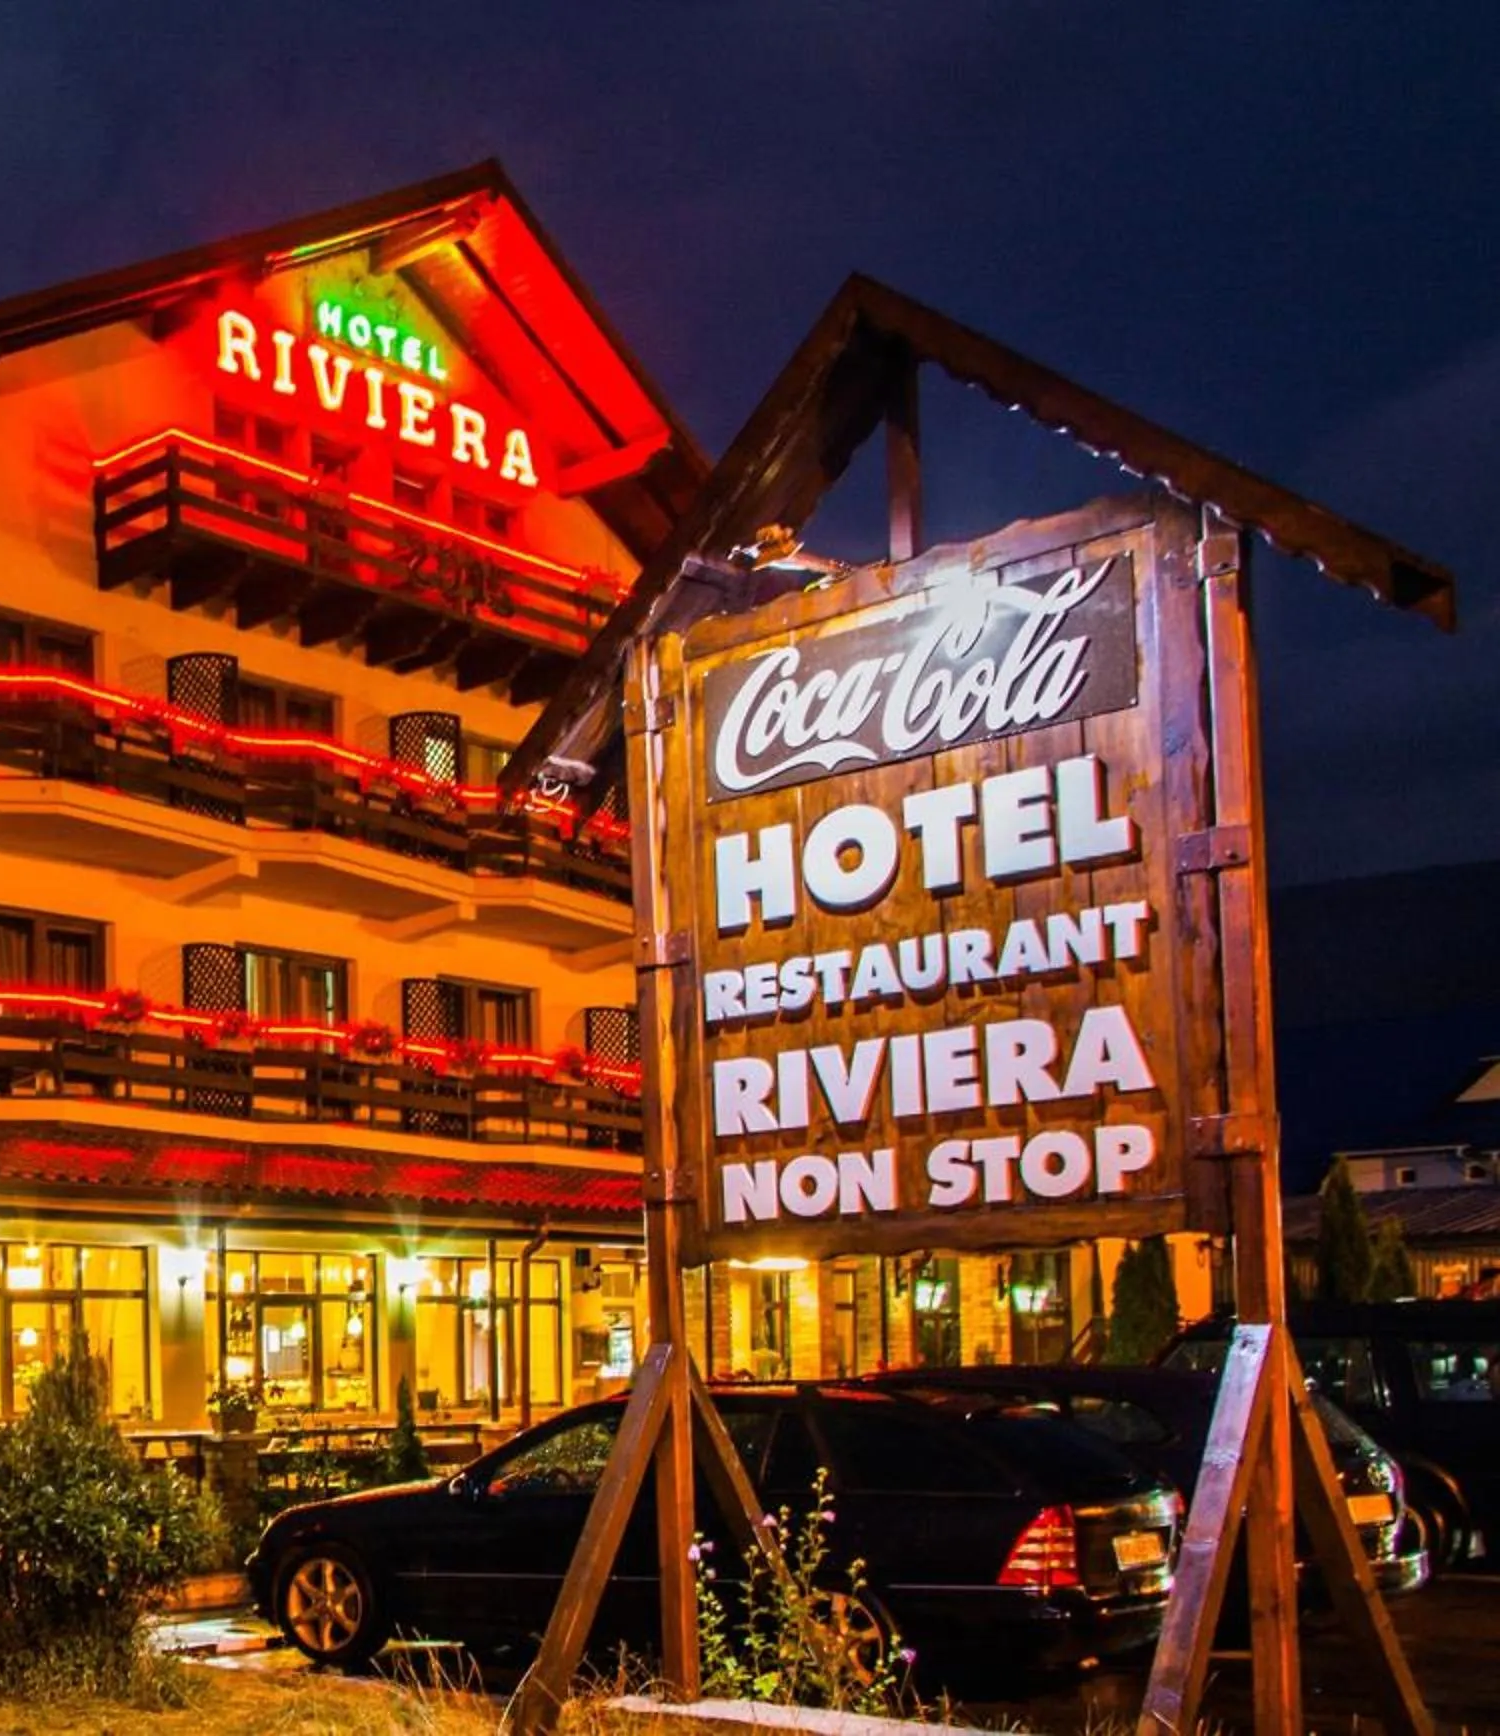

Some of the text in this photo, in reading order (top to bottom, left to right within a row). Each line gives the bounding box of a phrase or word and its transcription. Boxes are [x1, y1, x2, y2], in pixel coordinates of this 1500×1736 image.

[217, 310, 539, 487] RIVIERA
[318, 301, 448, 380] HOTEL
[715, 556, 1115, 791] Coca-Cola
[715, 754, 1134, 930] HOTEL
[704, 900, 1150, 1022] RESTAURANT
[713, 1004, 1156, 1137] RIVIERA
[723, 1125, 1155, 1223] NON STOP
